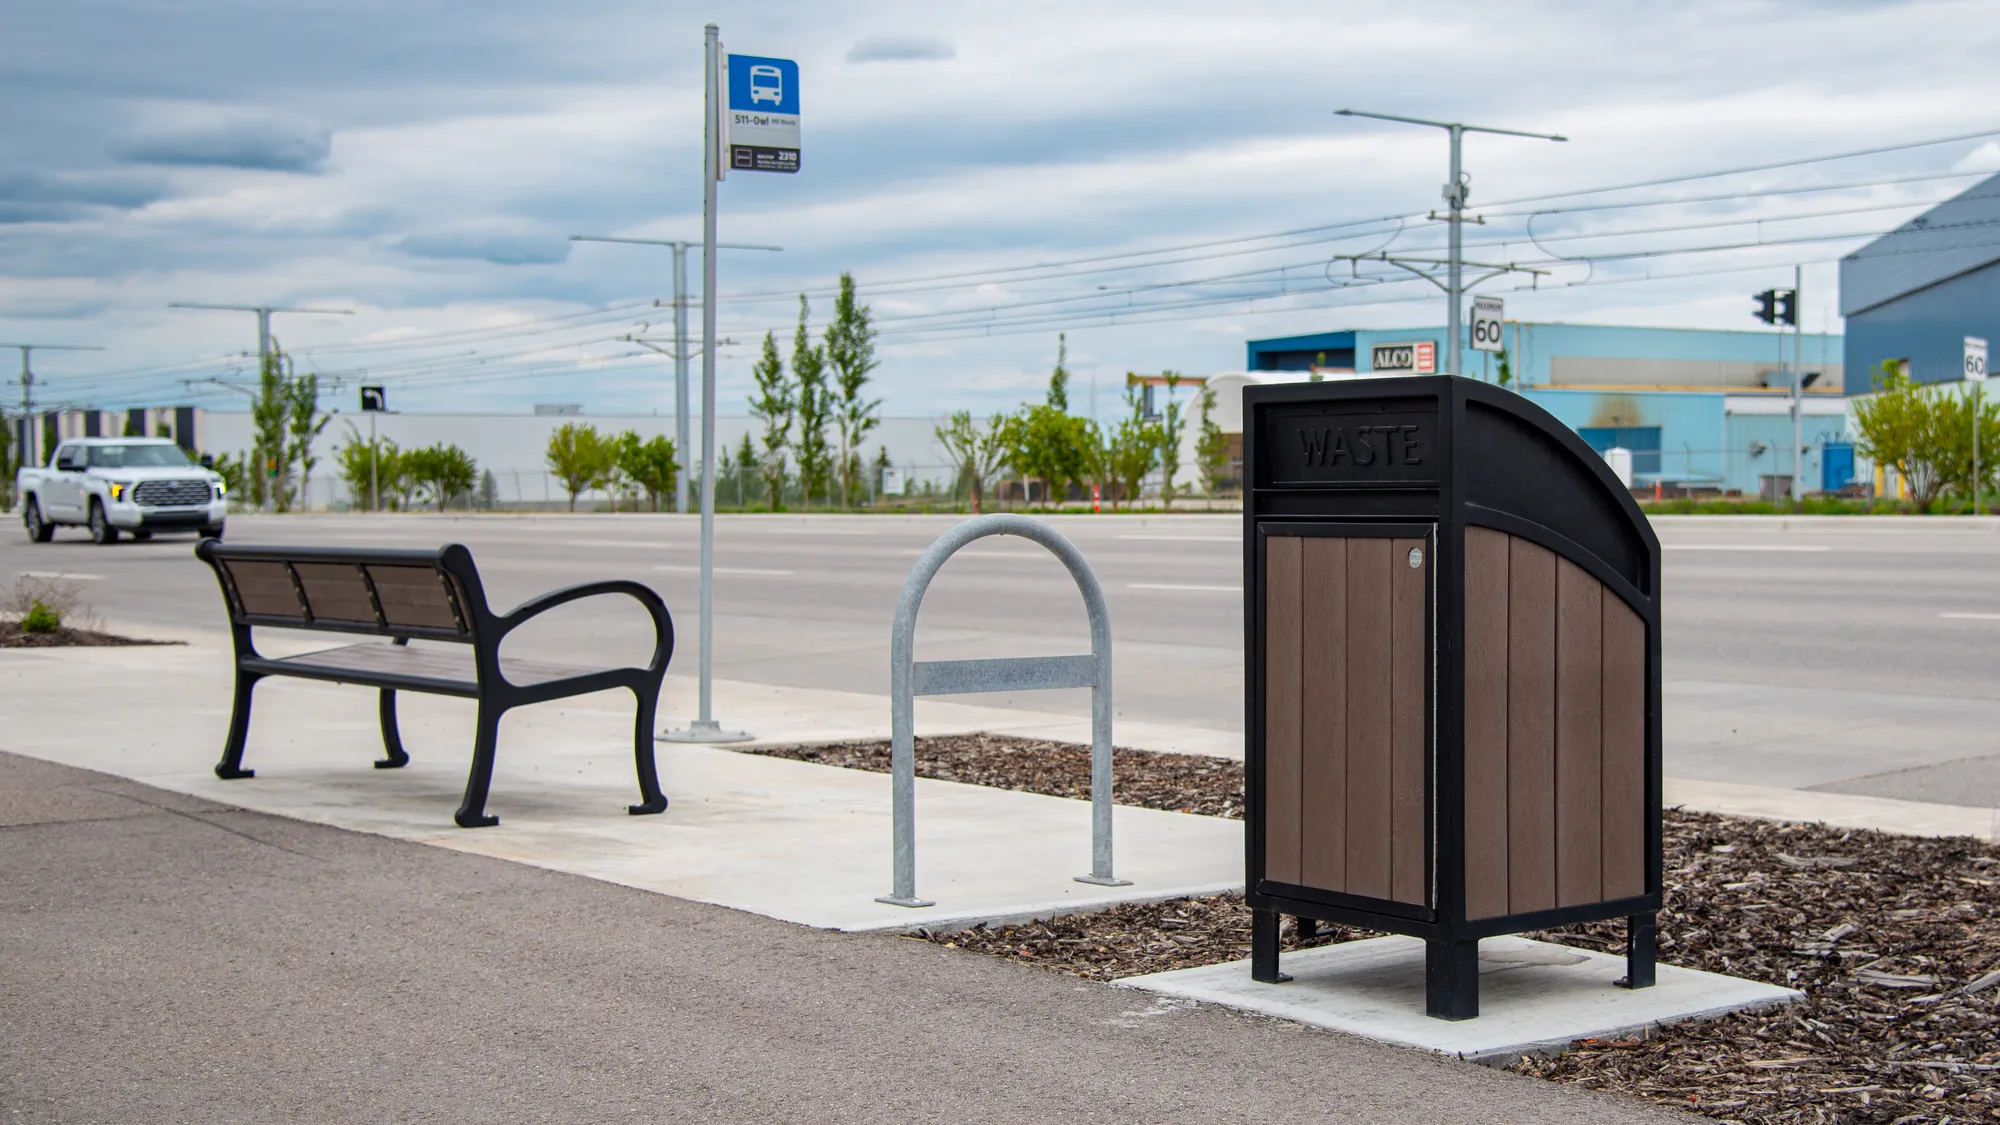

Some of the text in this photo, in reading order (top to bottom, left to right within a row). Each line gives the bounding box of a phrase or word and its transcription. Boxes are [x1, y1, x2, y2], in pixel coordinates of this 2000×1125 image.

[735, 114, 769, 126] 511-Owl
[778, 151, 797, 162] 2310
[1475, 320, 1500, 342] 60
[1374, 347, 1412, 368] ALCO
[1966, 354, 1984, 375] 60
[1297, 424, 1422, 467] WASTE
